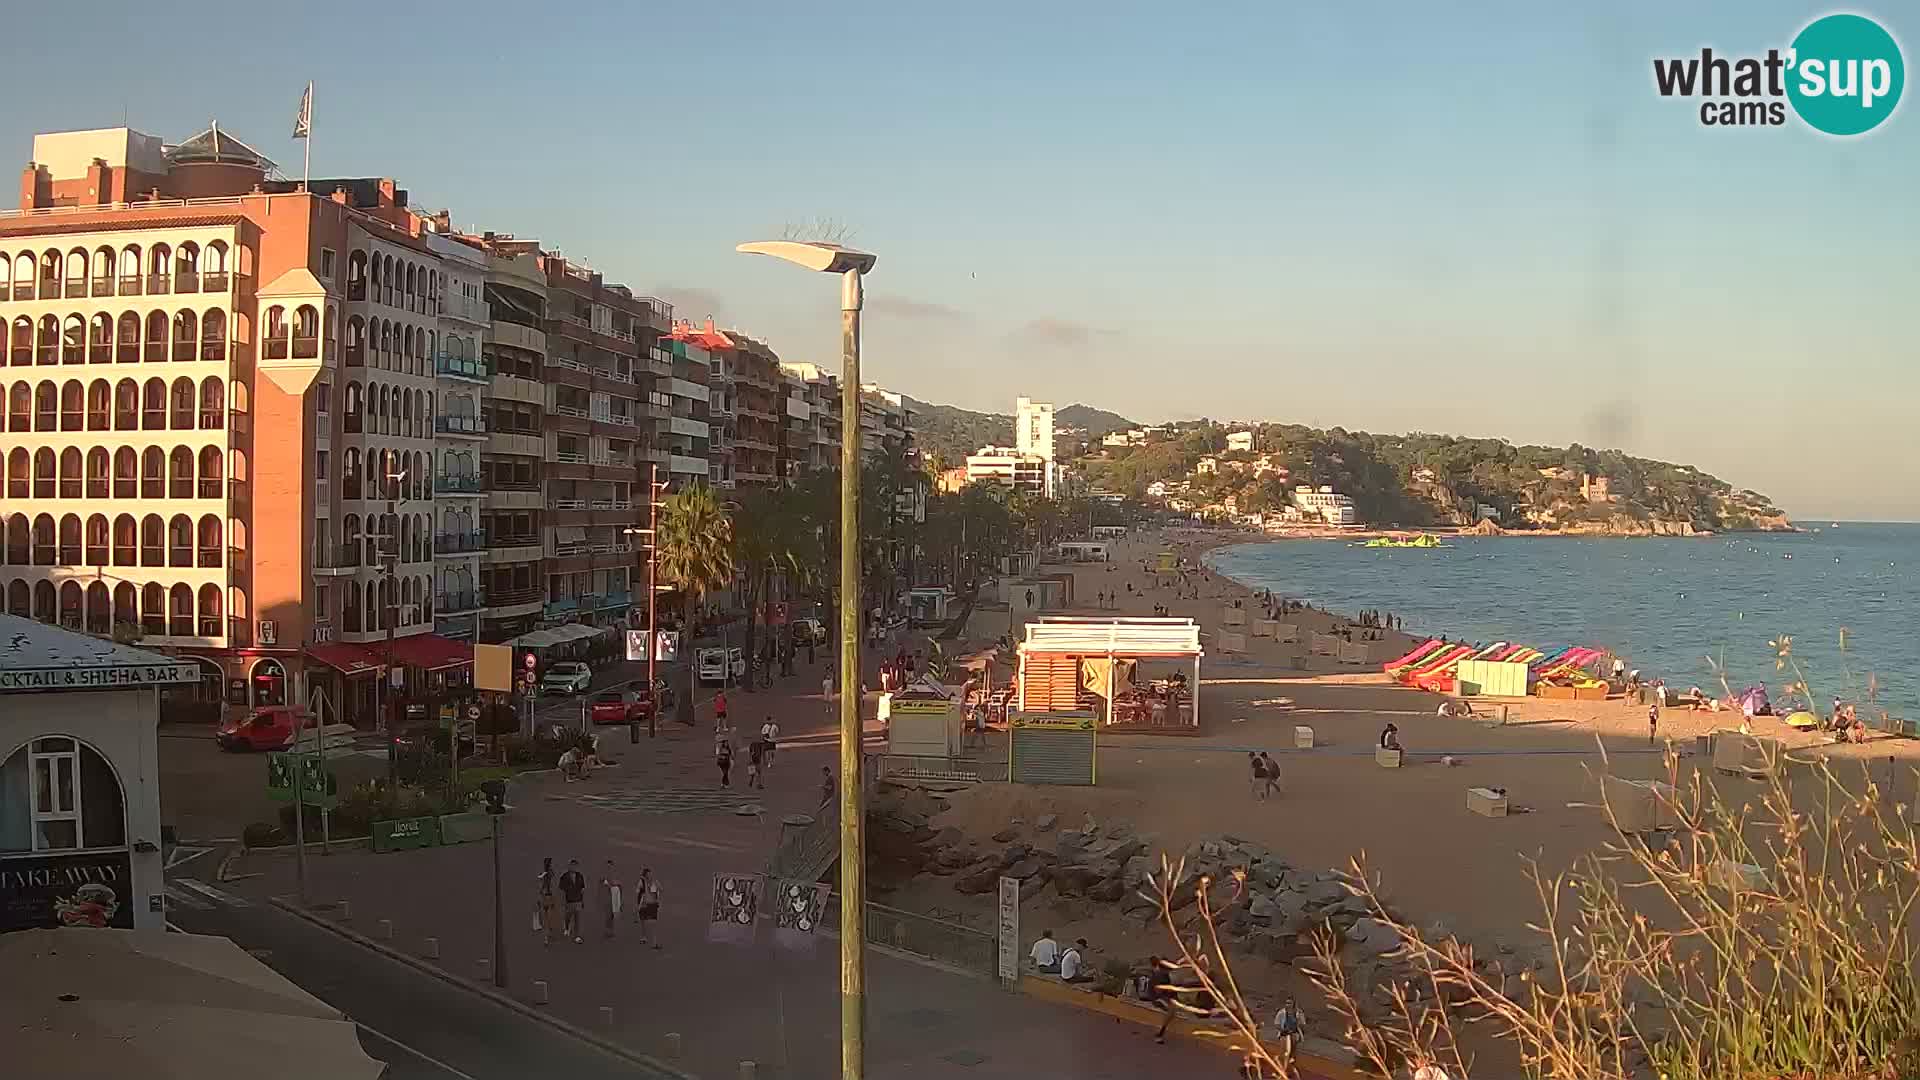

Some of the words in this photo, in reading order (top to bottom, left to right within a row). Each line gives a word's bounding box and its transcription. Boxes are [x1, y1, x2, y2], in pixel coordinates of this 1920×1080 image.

[64, 671, 75, 685] &
[81, 668, 142, 684] SHISHA
[147, 666, 179, 682] BAR
